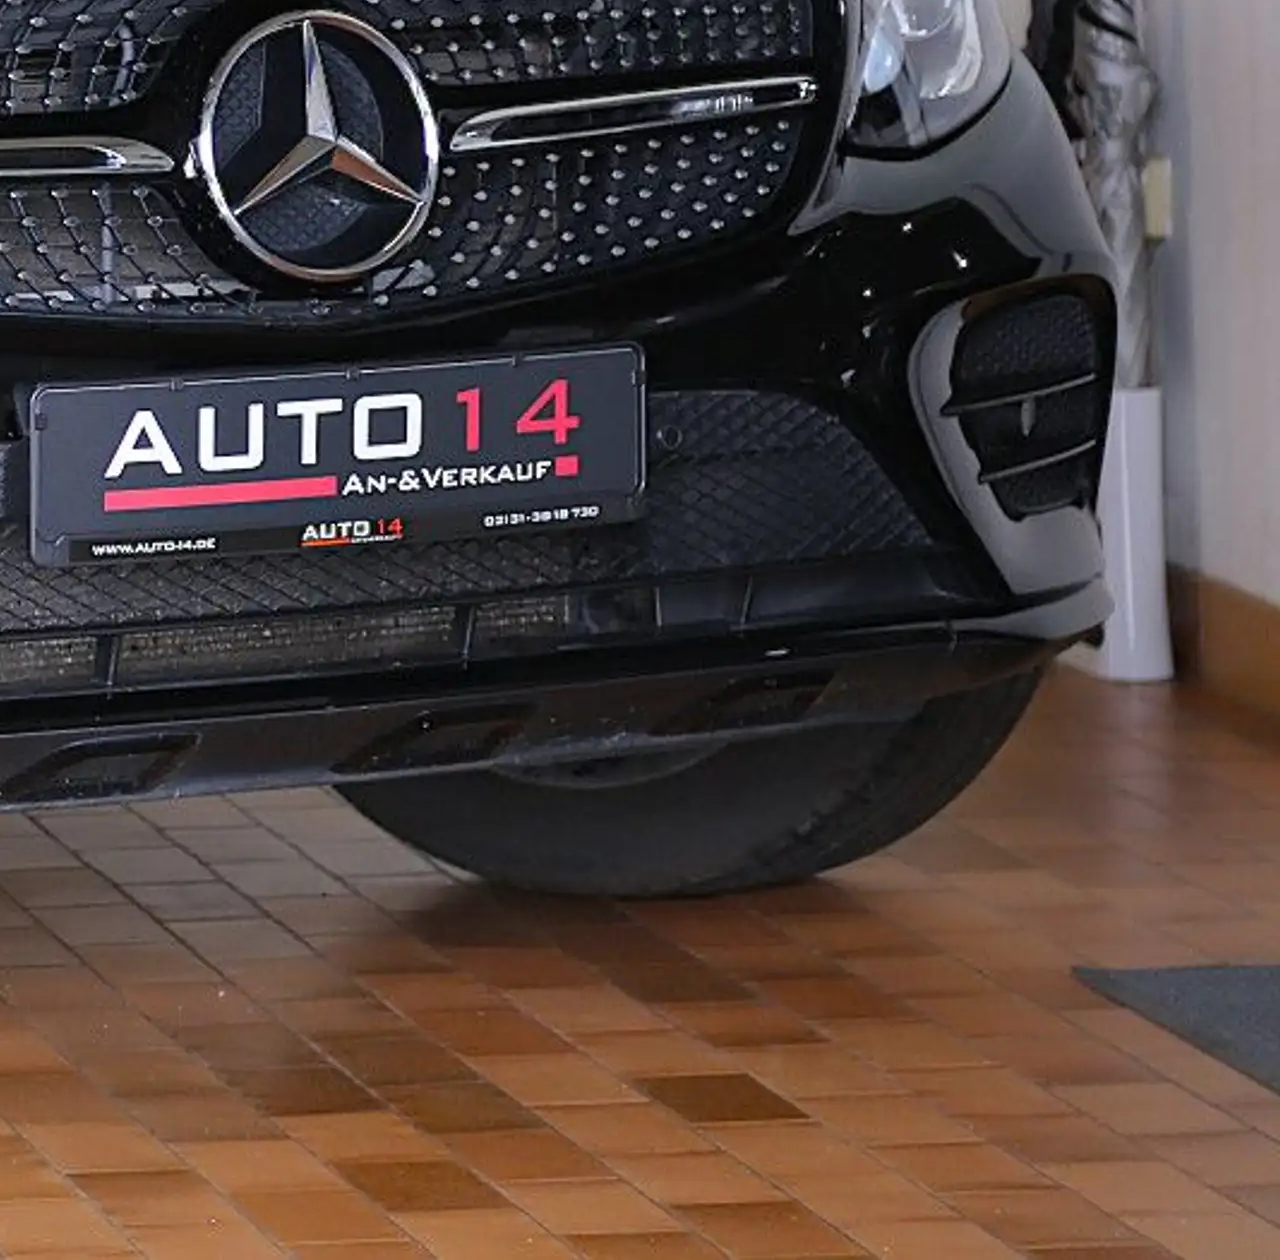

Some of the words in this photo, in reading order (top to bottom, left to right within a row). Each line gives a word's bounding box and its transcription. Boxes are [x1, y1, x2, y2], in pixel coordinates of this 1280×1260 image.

[105, 393, 423, 479] AUTO
[457, 378, 580, 452] 14
[342, 459, 553, 496] AN-&VERKAUF
[302, 520, 371, 541] AUTO
[377, 518, 403, 537] 14
